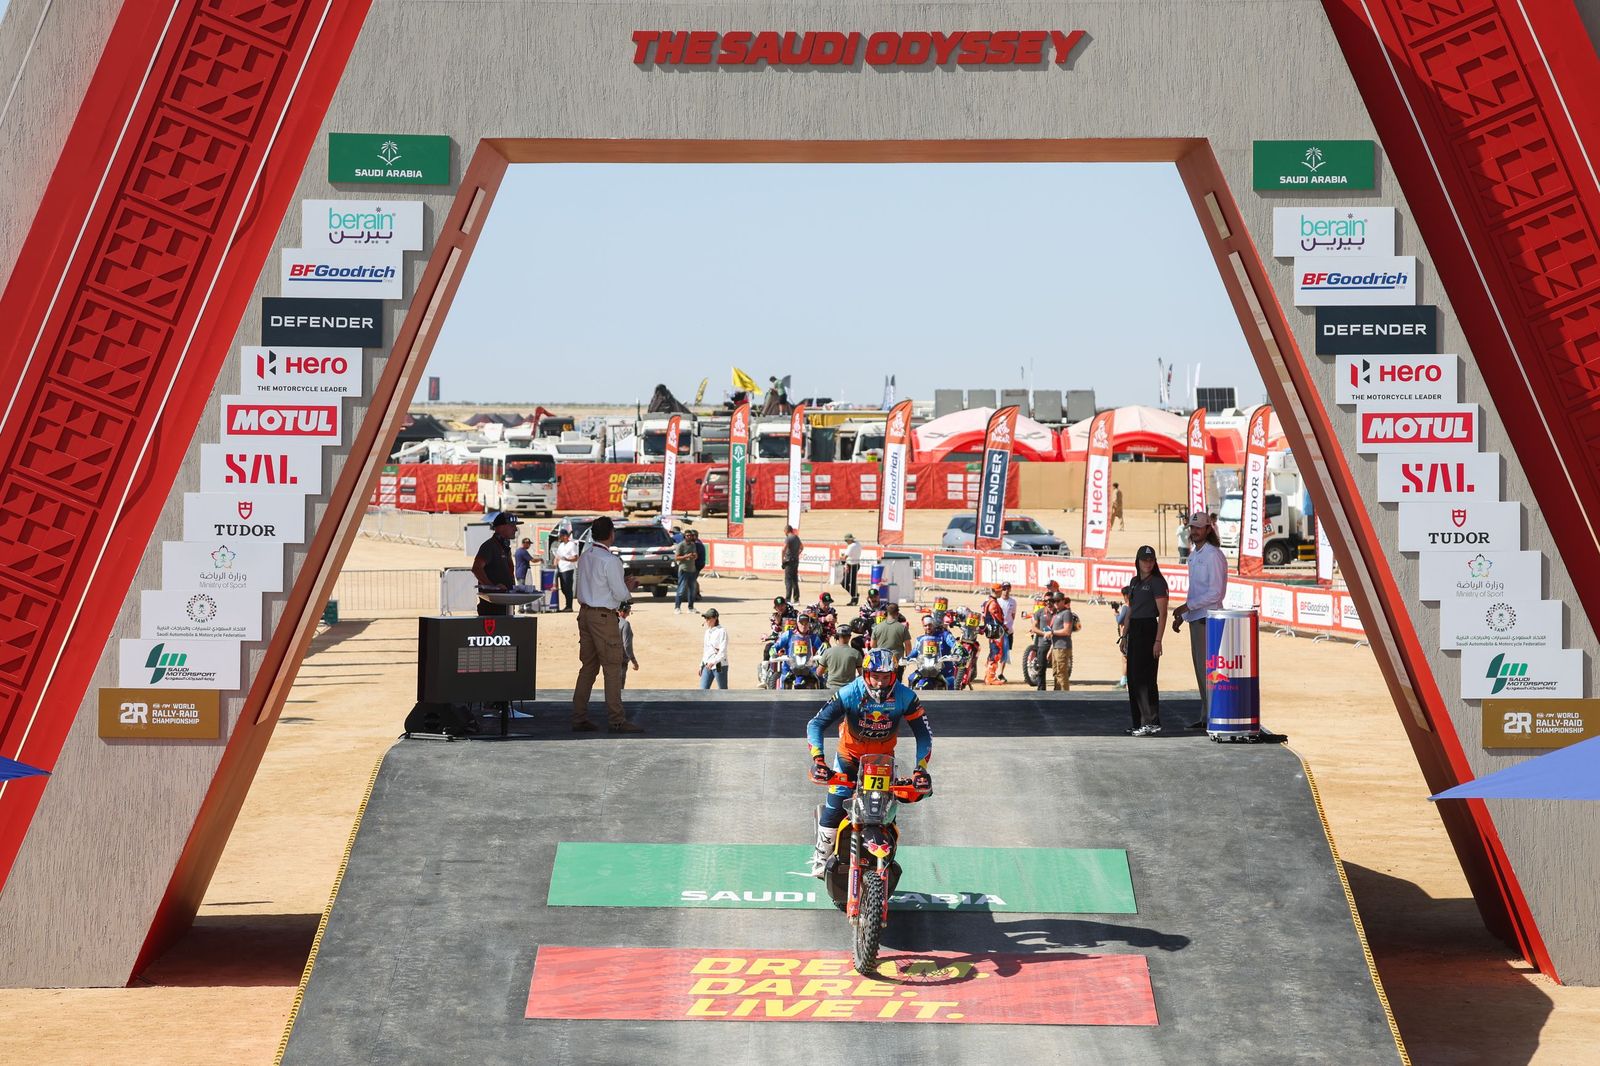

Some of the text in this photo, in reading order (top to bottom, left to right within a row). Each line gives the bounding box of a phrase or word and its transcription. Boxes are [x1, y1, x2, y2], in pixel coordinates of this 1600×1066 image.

[631, 30, 1087, 65] THE SAUDI ODYSSEY
[355, 168, 423, 178] SAUDI ARABIA
[1279, 176, 1348, 184] SAUDI ARABIA
[329, 207, 394, 230] berain
[1301, 213, 1366, 236] berain
[329, 230, 393, 245] بيرين
[1301, 237, 1365, 251] بيرين
[289, 264, 396, 279] BFGoodrich
[1302, 272, 1408, 285] BFGoodrich
[270, 315, 374, 329] DEFENDER
[1323, 324, 1427, 336] DEFENDER
[285, 356, 348, 375] Hero
[1379, 364, 1442, 382] Hero
[272, 385, 319, 393] MOTORCYCLE
[232, 409, 333, 432] MOTUL
[1367, 416, 1468, 439] MOTUL
[888, 451, 899, 522] BFGoodrich
[1092, 469, 1103, 513] Hero
[437, 493, 462, 503] LIVE
[984, 453, 1003, 535] DEFENDER
[1250, 476, 1261, 535] TUDOR
[214, 524, 276, 537] TUDOR
[1428, 532, 1490, 544] TUDOR
[935, 562, 973, 575] DEFENDER
[1056, 567, 1076, 577] Hero
[199, 581, 221, 589] Ministry
[229, 581, 247, 589] Sport
[1456, 580, 1505, 590] وزارة الرياضة
[1455, 590, 1478, 598] Ministry
[1487, 590, 1504, 598] Sport
[1300, 601, 1330, 612] BFGoodrich
[467, 635, 511, 647] TUDOR
[1218, 655, 1243, 669] Bull
[119, 702, 148, 724] 2R
[152, 710, 199, 718] RALLY-RAID
[152, 717, 200, 725] CHAMPIONSHIP
[1503, 712, 1532, 734] 2R
[1536, 719, 1583, 727] RALLY-RAID
[870, 776, 884, 790] 73
[680, 889, 817, 903] SAUDI
[687, 977, 919, 998] DARE.
[684, 998, 965, 1020] LIVE IT.
